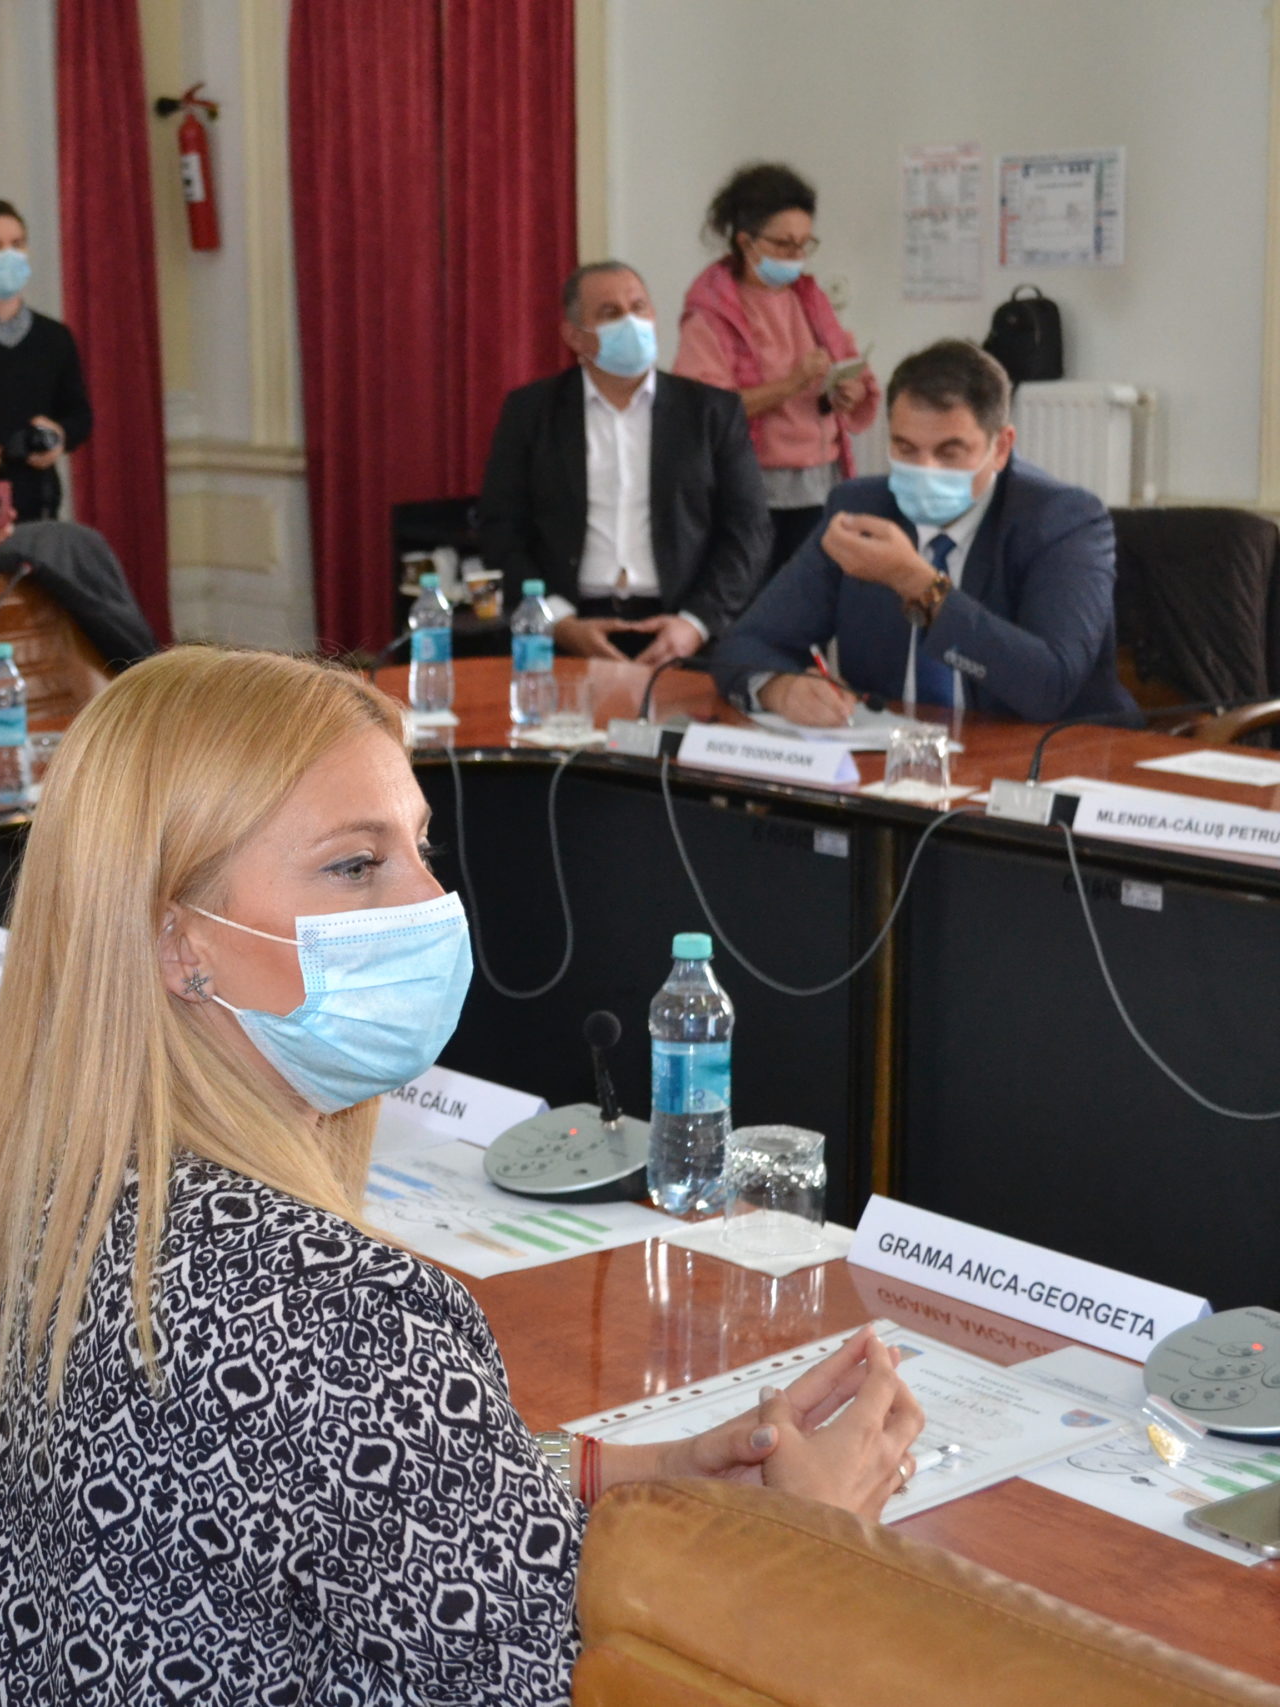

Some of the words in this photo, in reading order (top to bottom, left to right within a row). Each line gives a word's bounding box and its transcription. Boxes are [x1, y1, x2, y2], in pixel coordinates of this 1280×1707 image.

[419, 1090, 468, 1120] CĂLIN
[877, 1231, 954, 1275] GRAMA
[956, 1256, 1156, 1341] ANCA-GEORGETA
